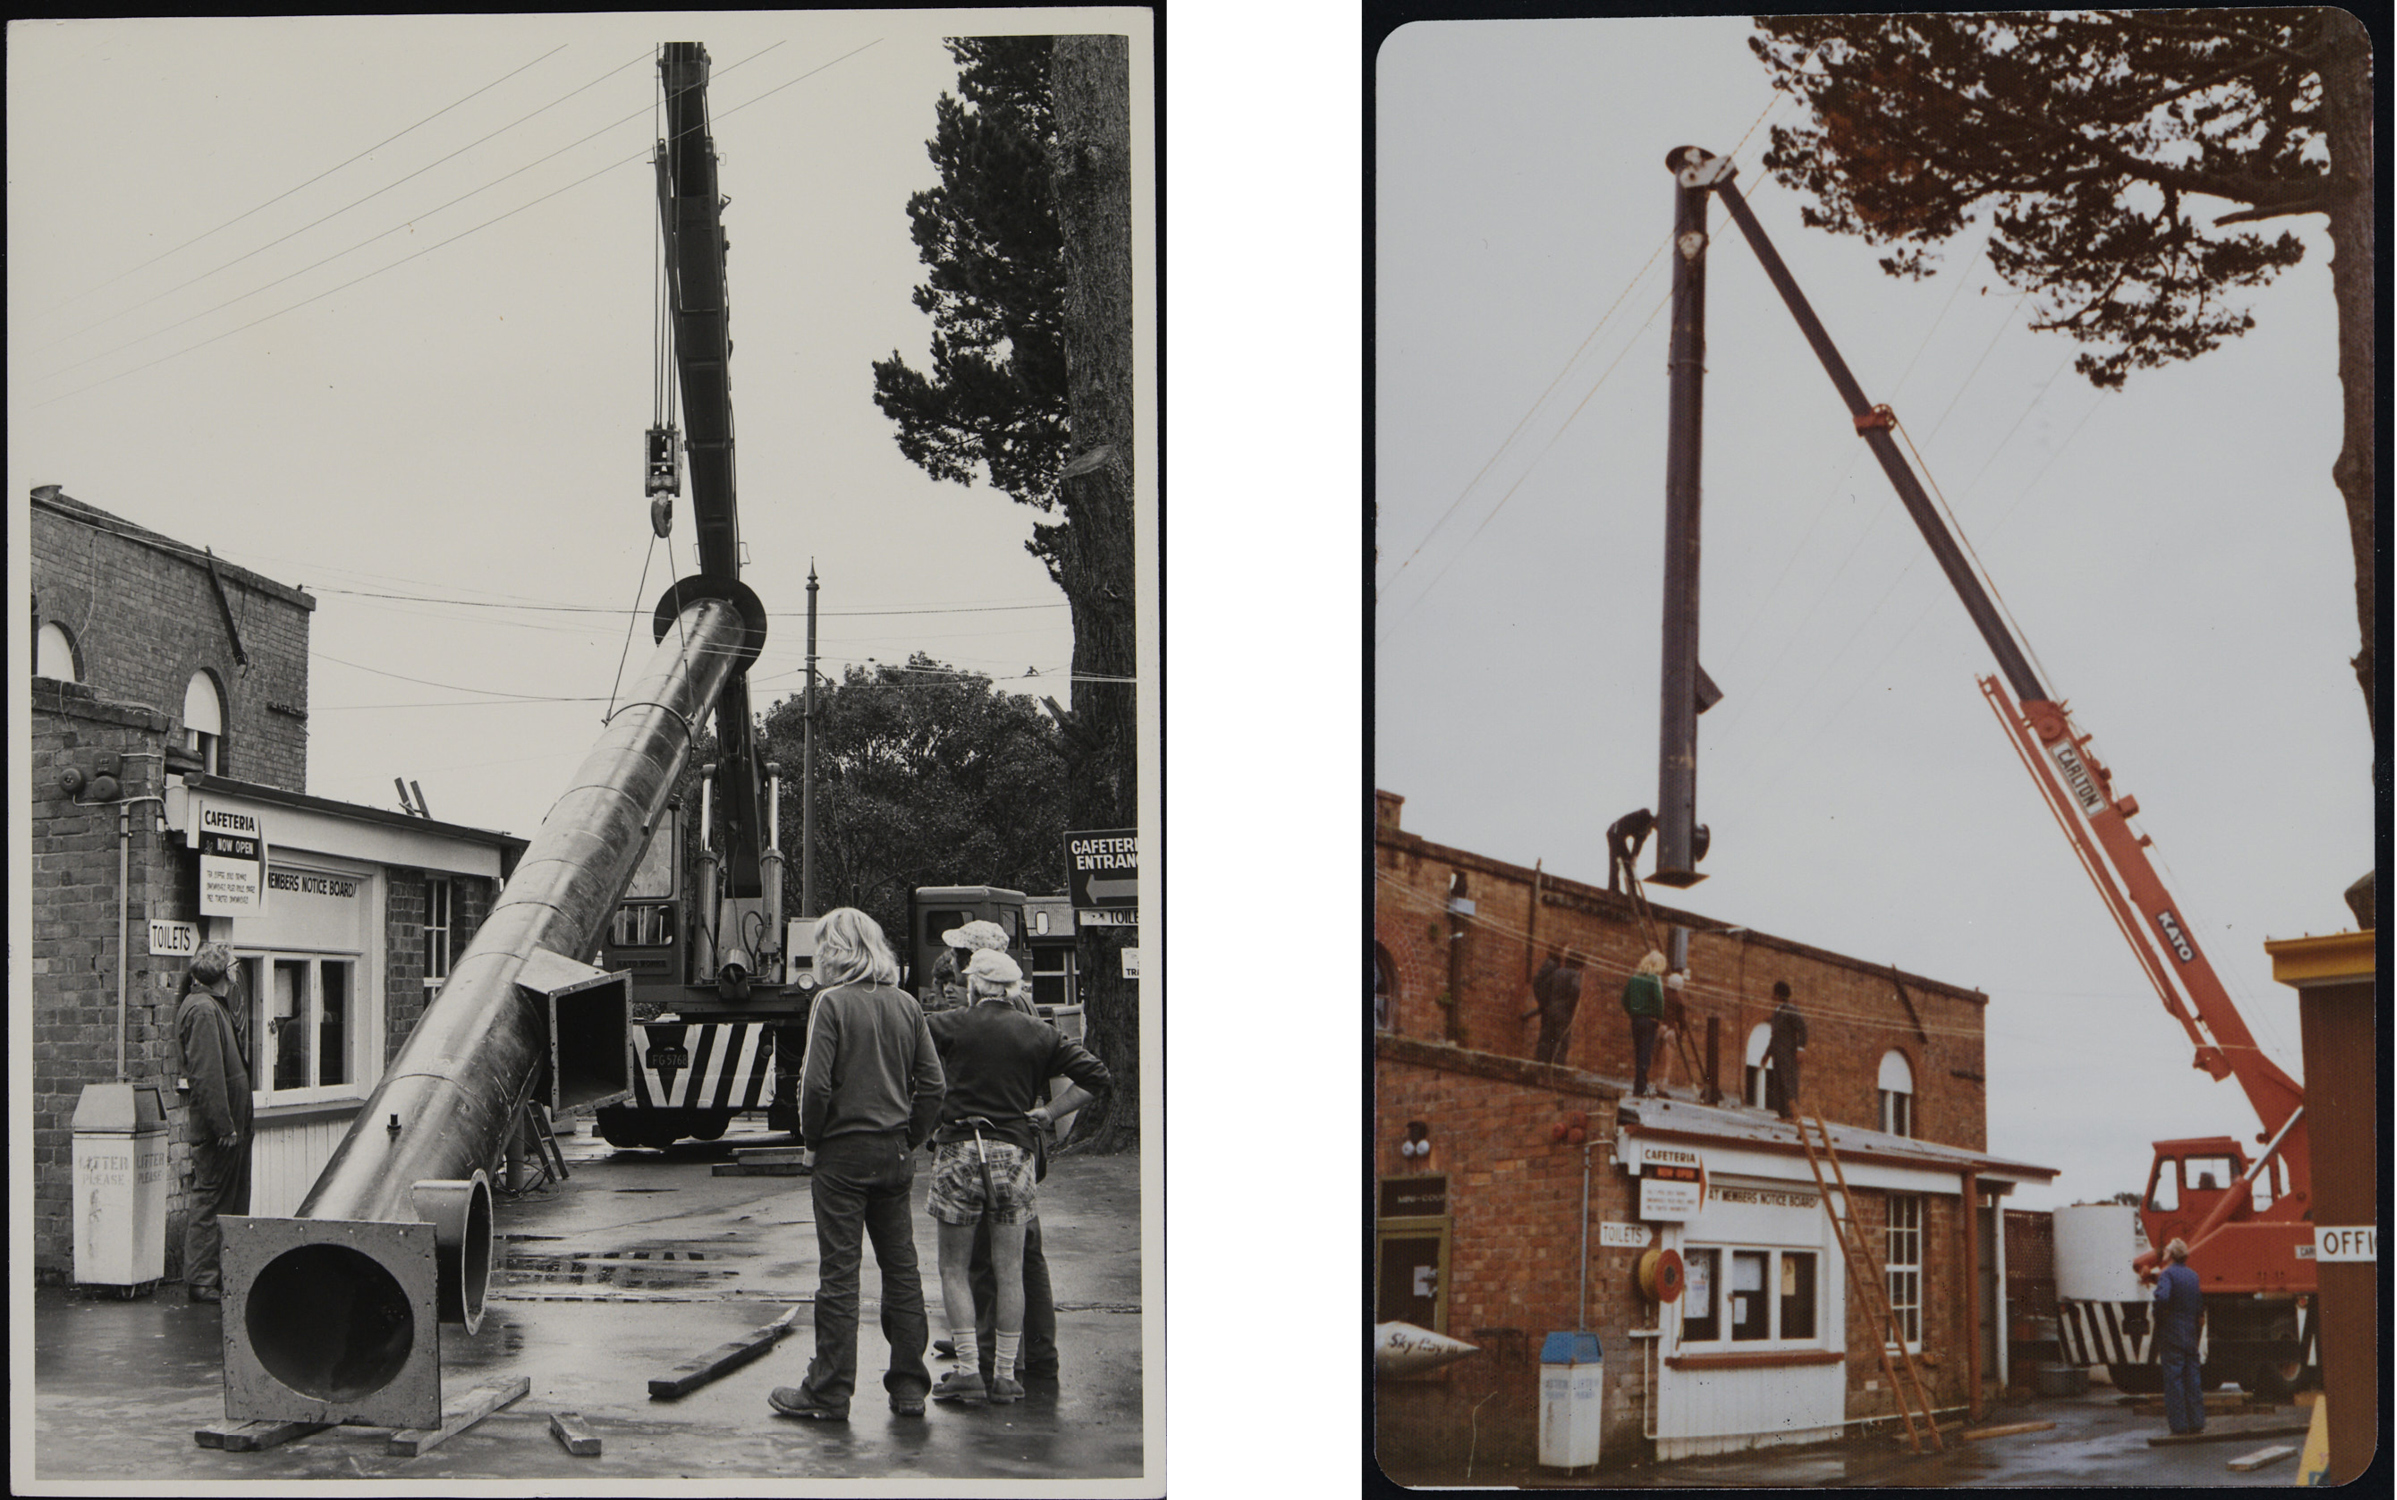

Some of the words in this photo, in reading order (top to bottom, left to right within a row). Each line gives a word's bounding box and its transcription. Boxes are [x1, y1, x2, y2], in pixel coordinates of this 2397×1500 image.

[2057, 748, 2101, 808] CARLTON
[204, 809, 255, 832] CAFETERIA
[217, 837, 233, 852] NOW
[235, 840, 254, 855] OPEN
[1076, 853, 1138, 870] ENTRAN
[301, 876, 327, 895] NOTICE
[152, 924, 191, 951] TOILETS
[2157, 910, 2195, 962] KATO
[136, 1152, 165, 1169] LITTER
[1645, 1149, 1696, 1164] CAFETERIA
[83, 1173, 125, 1185] PLEASE
[1722, 1188, 1758, 1204] MEMBERS
[1760, 1192, 1787, 1207] NOTICE
[1603, 1225, 1643, 1244] TOILETS
[2323, 1230, 2377, 1255] OFFI
